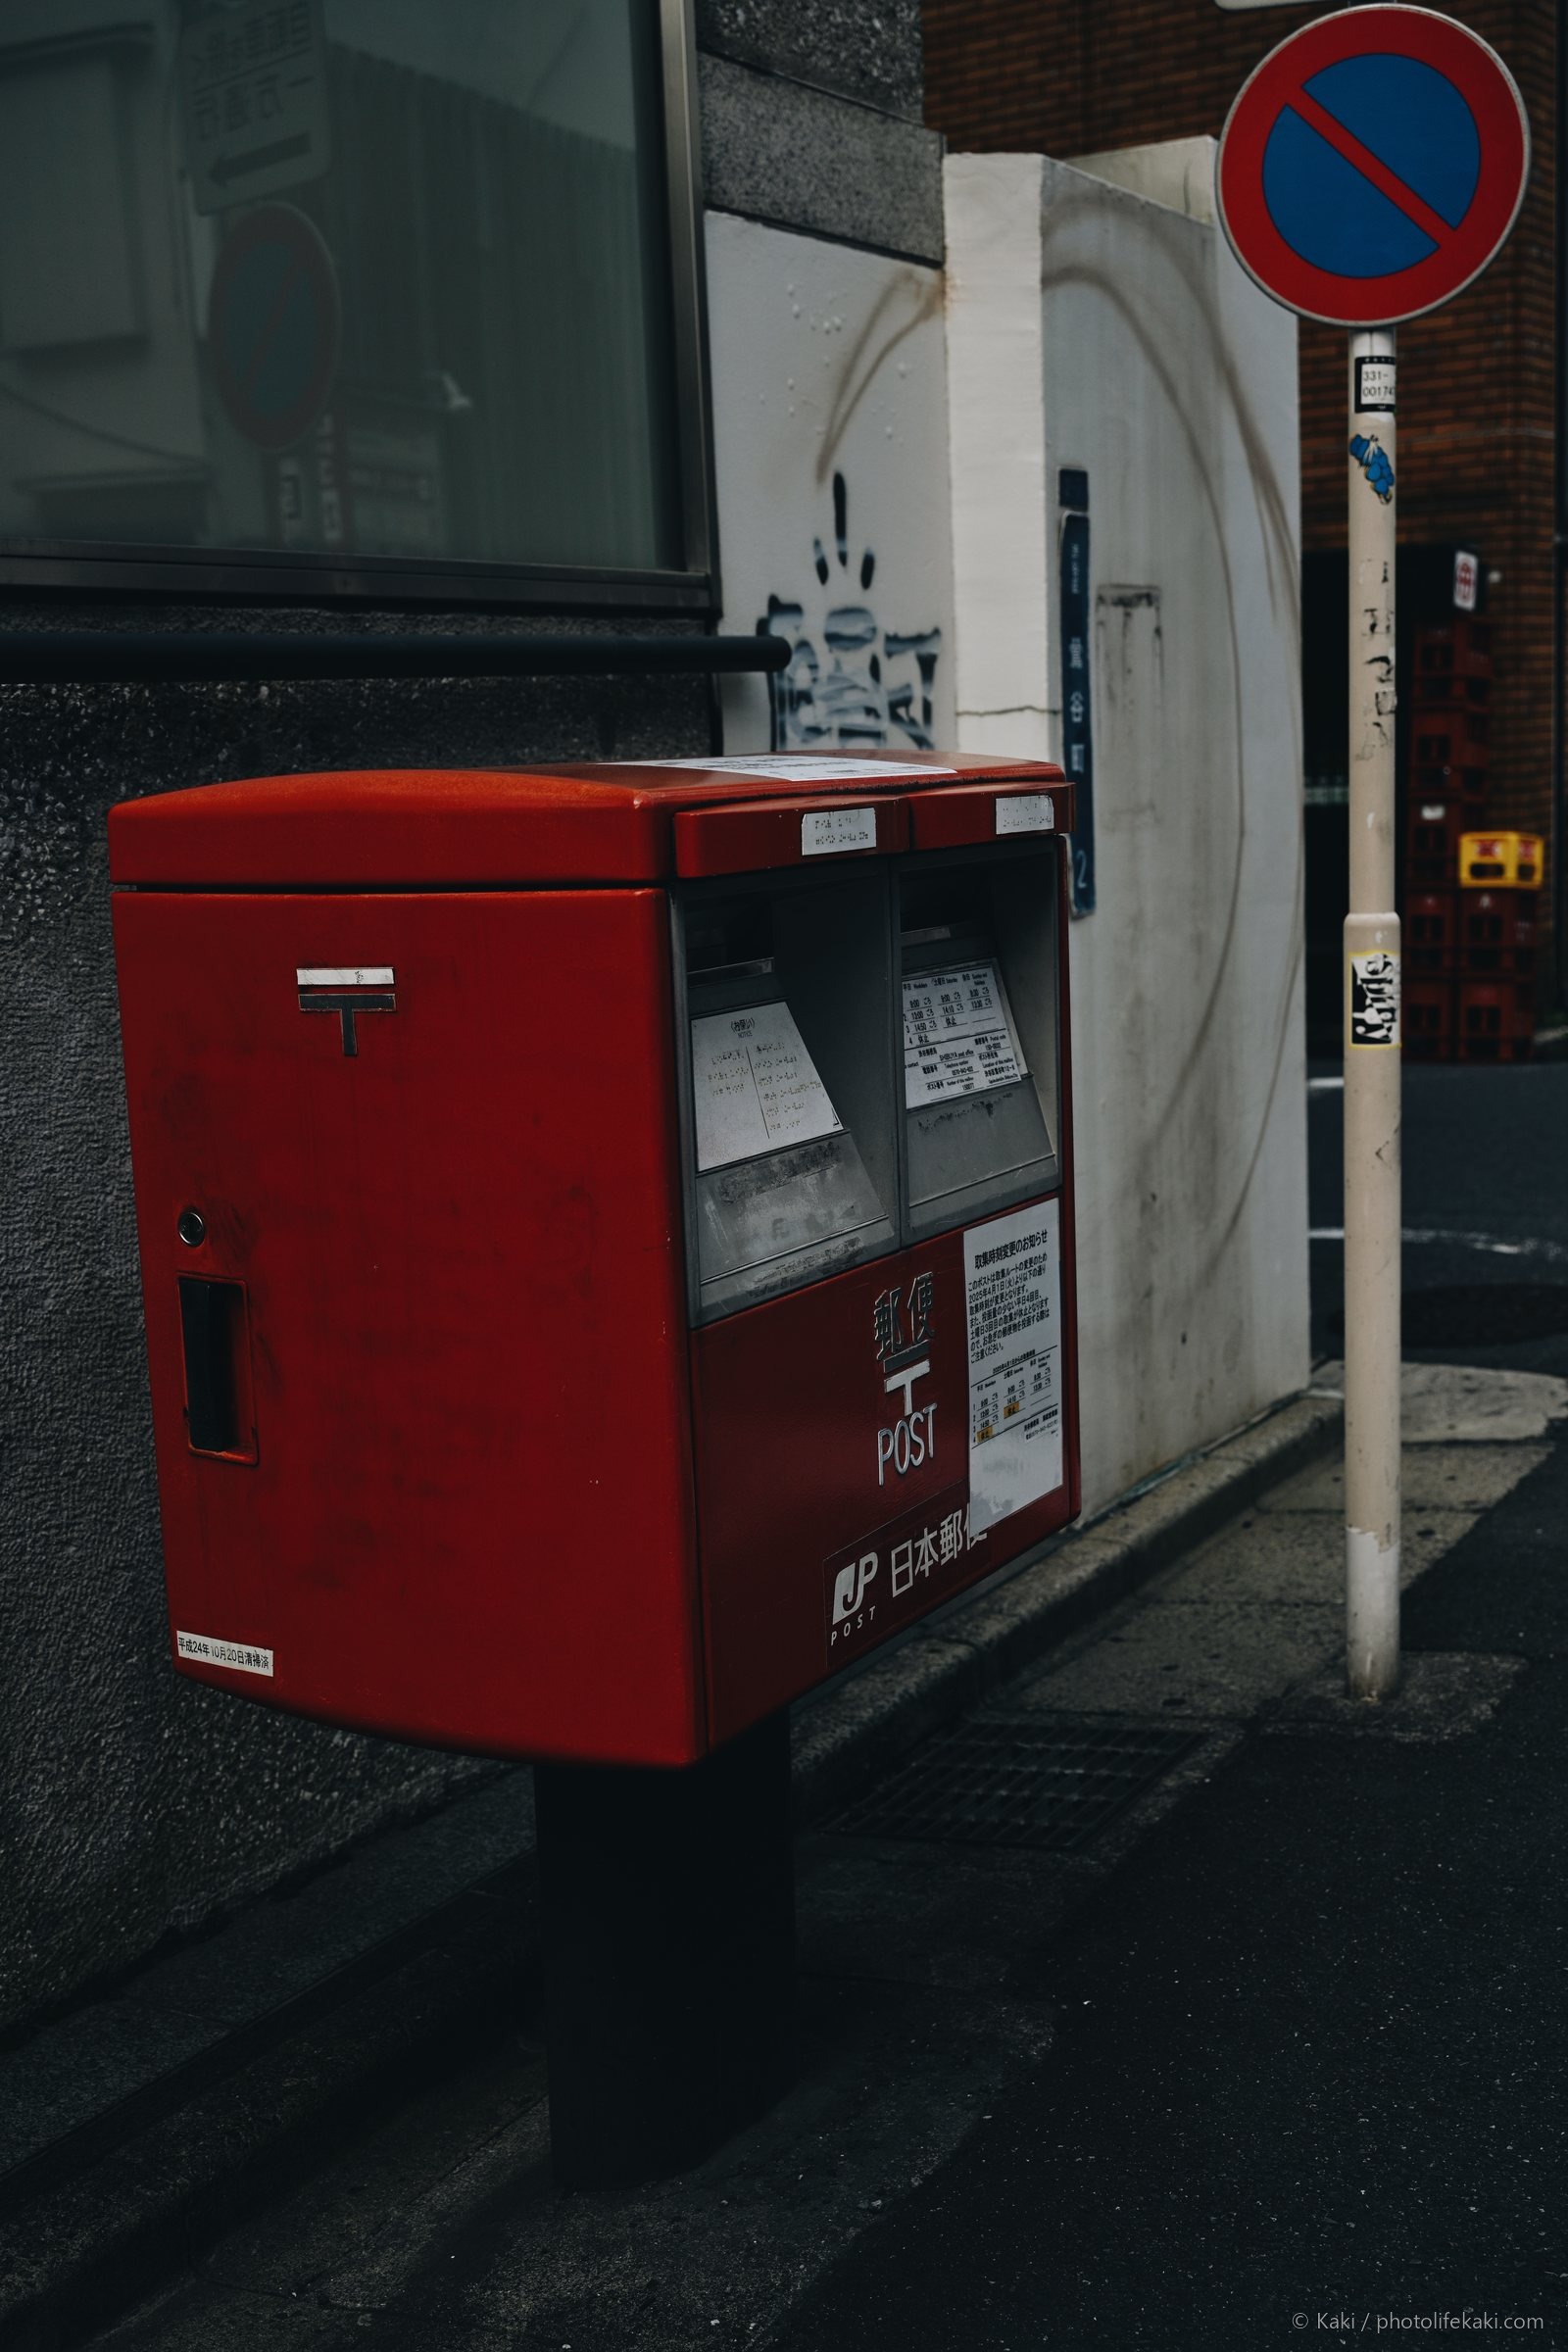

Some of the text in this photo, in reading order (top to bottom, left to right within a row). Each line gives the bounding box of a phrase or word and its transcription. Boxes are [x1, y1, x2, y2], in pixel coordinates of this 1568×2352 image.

[974, 1229, 1048, 1270] 取集時刻変更のお知らせ
[874, 1271, 935, 1361] 郵便
[878, 1402, 938, 1487] POST
[831, 1605, 876, 1646] POST
